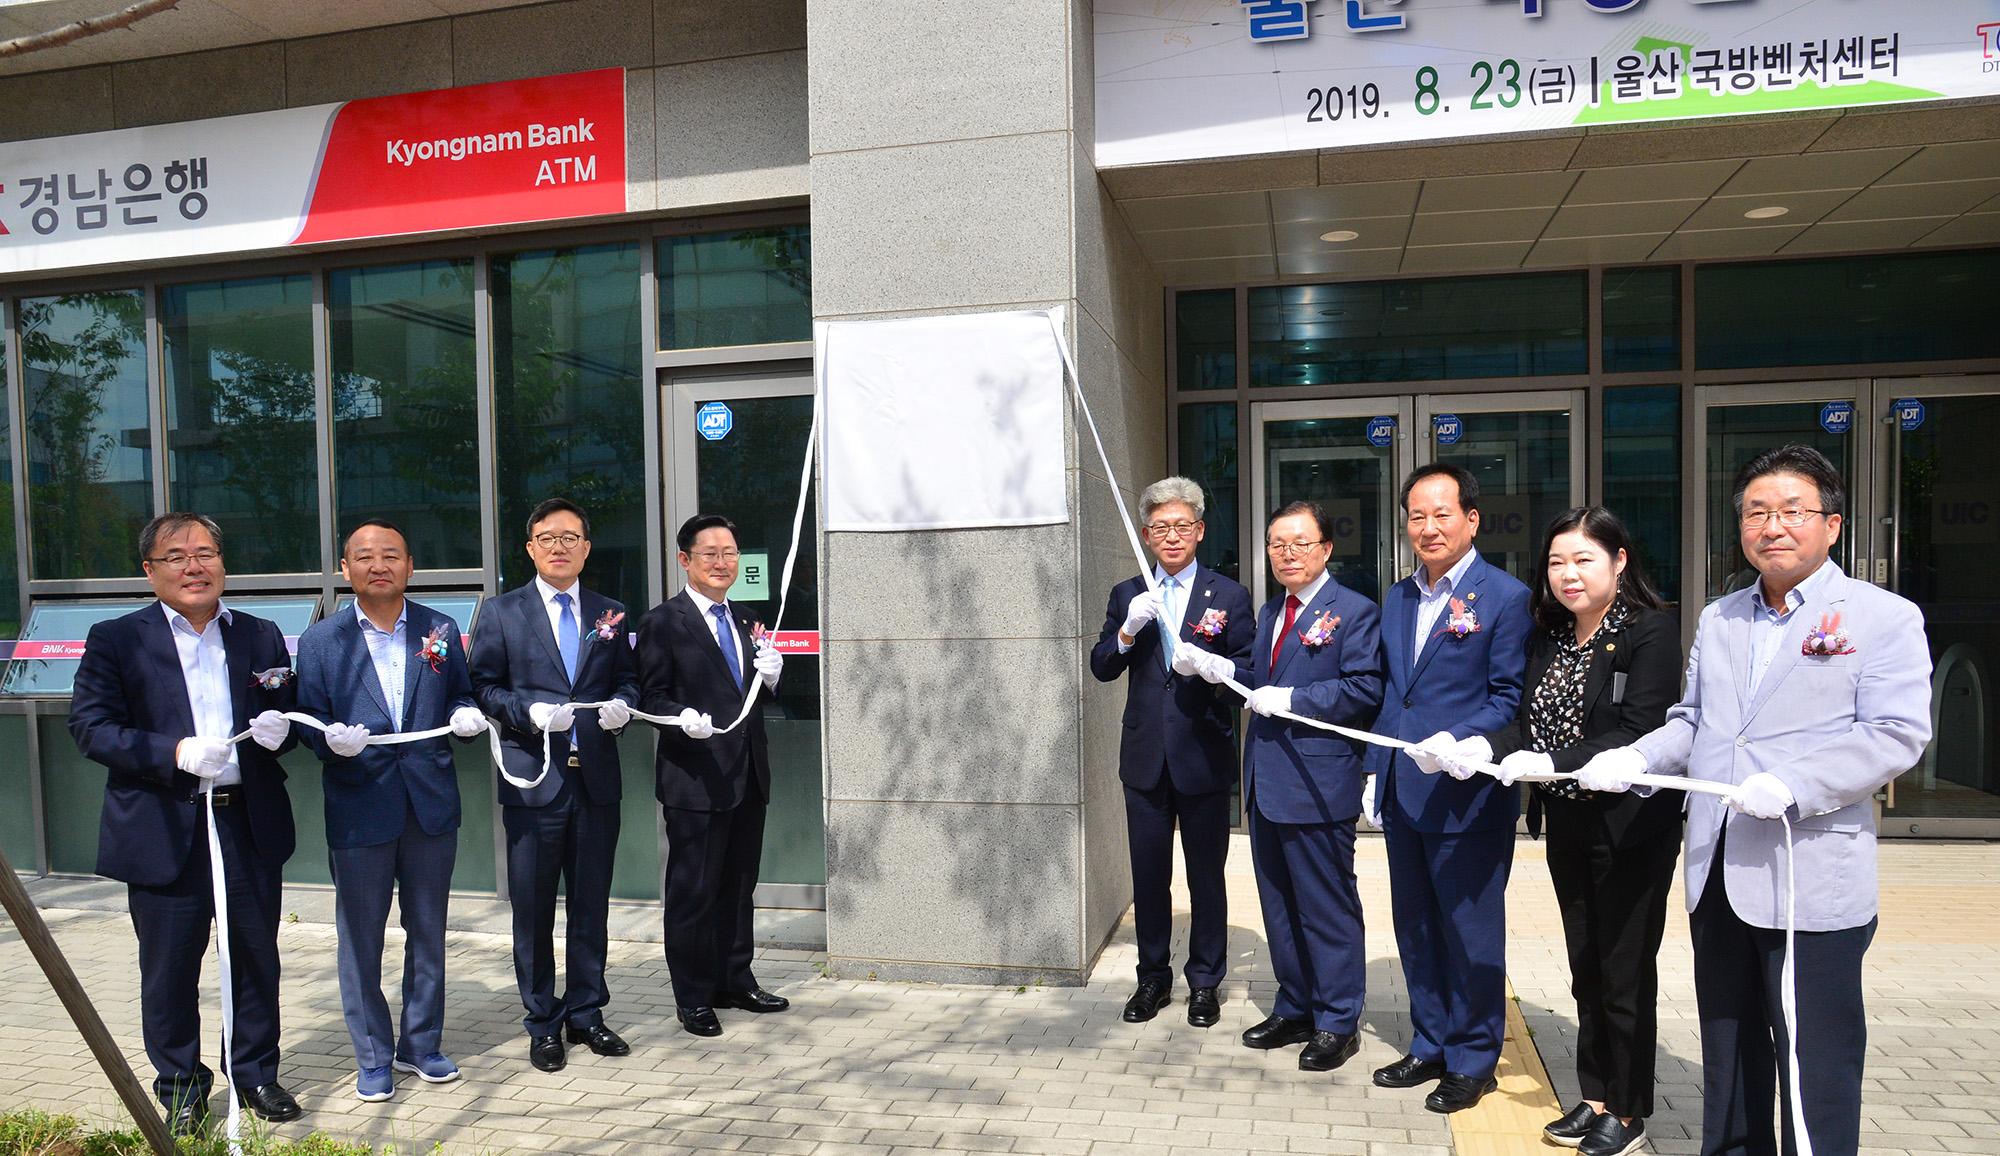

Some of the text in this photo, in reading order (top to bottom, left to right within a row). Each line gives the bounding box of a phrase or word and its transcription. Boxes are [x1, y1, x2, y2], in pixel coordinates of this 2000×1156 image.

[1307, 82, 1389, 122] 2019.
[1415, 66, 1450, 116] 8.
[1613, 52, 1679, 98] 울산
[1692, 32, 1899, 92] 국방벤처센터
[386, 118, 595, 166] Kyongnam Bank
[535, 155, 596, 186] ATM
[19, 157, 208, 235] 경남은행
[703, 413, 727, 428] ADT
[1826, 411, 1849, 424] ADT
[1372, 426, 1392, 437] ADT
[1438, 423, 1457, 435] ADT
[1941, 501, 1989, 525] UIC
[1479, 513, 1523, 535] UIC
[41, 644, 65, 654] BNK
[790, 639, 810, 648] Bank
